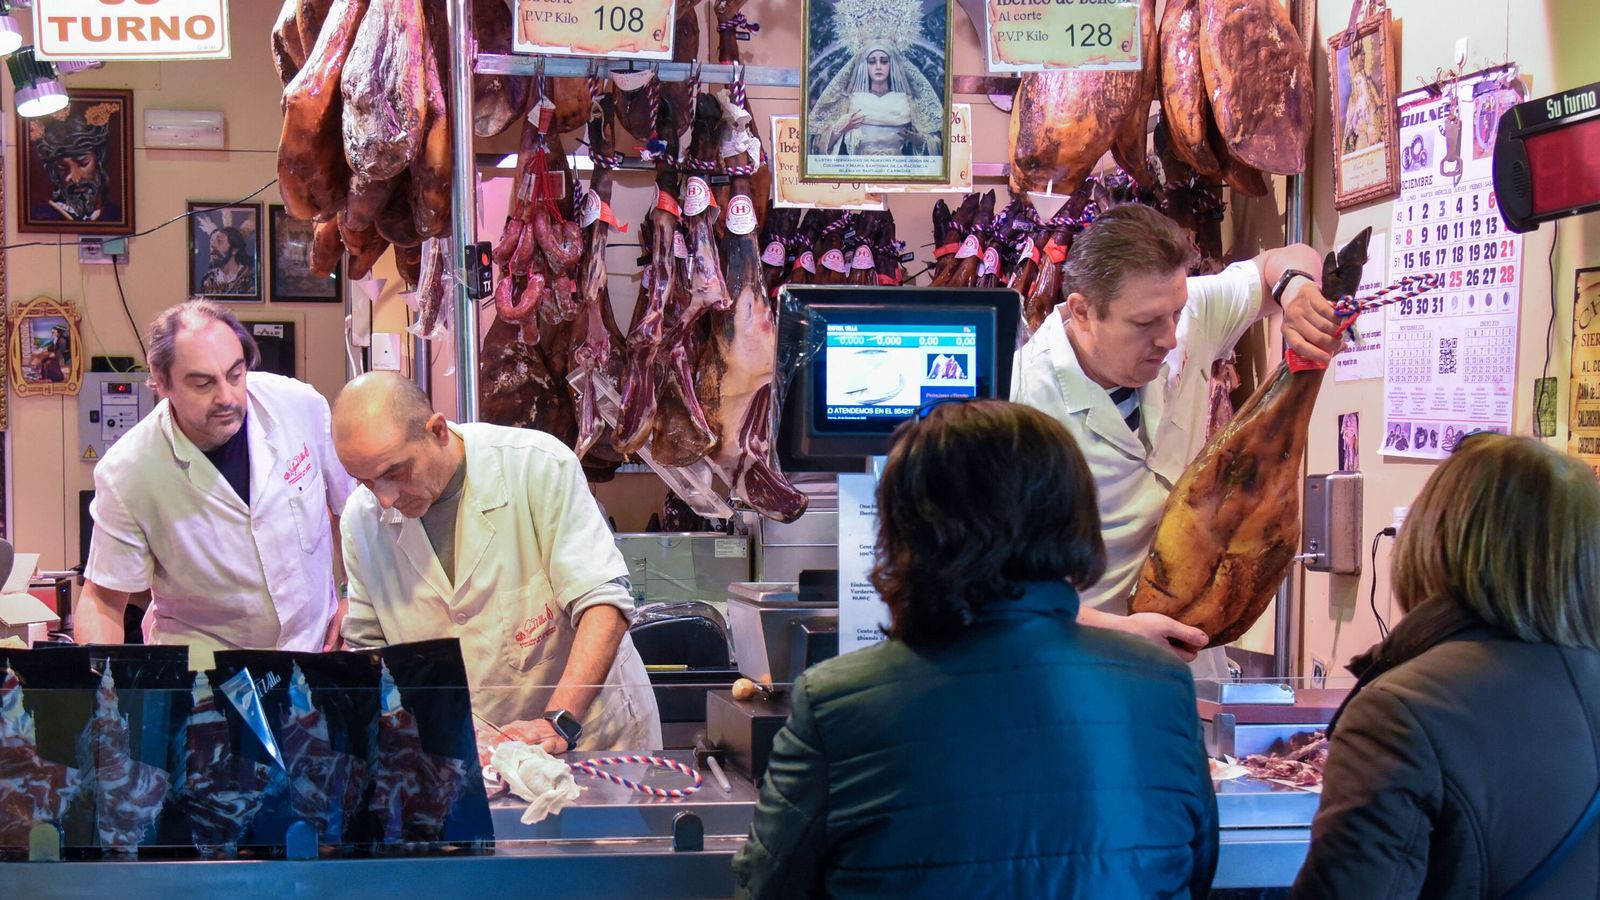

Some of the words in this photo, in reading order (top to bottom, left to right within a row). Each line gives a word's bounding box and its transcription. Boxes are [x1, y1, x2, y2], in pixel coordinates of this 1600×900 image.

[525, 10, 553, 22] P.V.P
[555, 12, 579, 24] Kilo
[594, 5, 644, 32] 108
[998, 12, 1010, 22] Al
[1013, 11, 1042, 21] corte
[48, 14, 216, 42] TURNO
[653, 29, 662, 42] €
[997, 31, 1024, 42] P.V.P
[1026, 30, 1049, 42] Kilo
[1065, 23, 1113, 47] 128
[1121, 40, 1130, 52] €
[1546, 98, 1562, 119] Su
[1564, 90, 1597, 116] turno
[788, 127, 800, 139] Pa
[951, 134, 967, 144] ota
[780, 141, 800, 153] Ibé
[780, 162, 794, 171] Por
[1401, 175, 1433, 190] ICIEMBRE
[688, 187, 696, 196] H
[735, 206, 746, 214] H
[1408, 205, 1413, 221] 1
[1422, 203, 1429, 219] 2
[1439, 200, 1446, 217] 3
[1456, 197, 1463, 214] 4
[1472, 194, 1479, 212] 5
[1488, 191, 1496, 209] 6
[1406, 228, 1413, 246] 8
[1421, 226, 1428, 243] 9
[1436, 224, 1448, 241] 10
[1453, 221, 1464, 239] 11
[1470, 219, 1481, 237] 12
[1486, 216, 1498, 235] 13
[1403, 252, 1414, 269] 15
[1419, 250, 1431, 268] 16
[1435, 248, 1447, 265] 17
[1452, 245, 1464, 263] 18
[1469, 243, 1480, 261] 19
[1483, 241, 1498, 260] 20
[1500, 239, 1514, 258] 21
[1449, 270, 1463, 288] 25
[1466, 268, 1479, 287] 26
[1482, 267, 1497, 285] 27
[1499, 265, 1515, 284] 28
[482, 280, 492, 293] TX
[1400, 298, 1413, 316] 29
[1415, 297, 1429, 315] 30
[1431, 296, 1444, 314] 31
